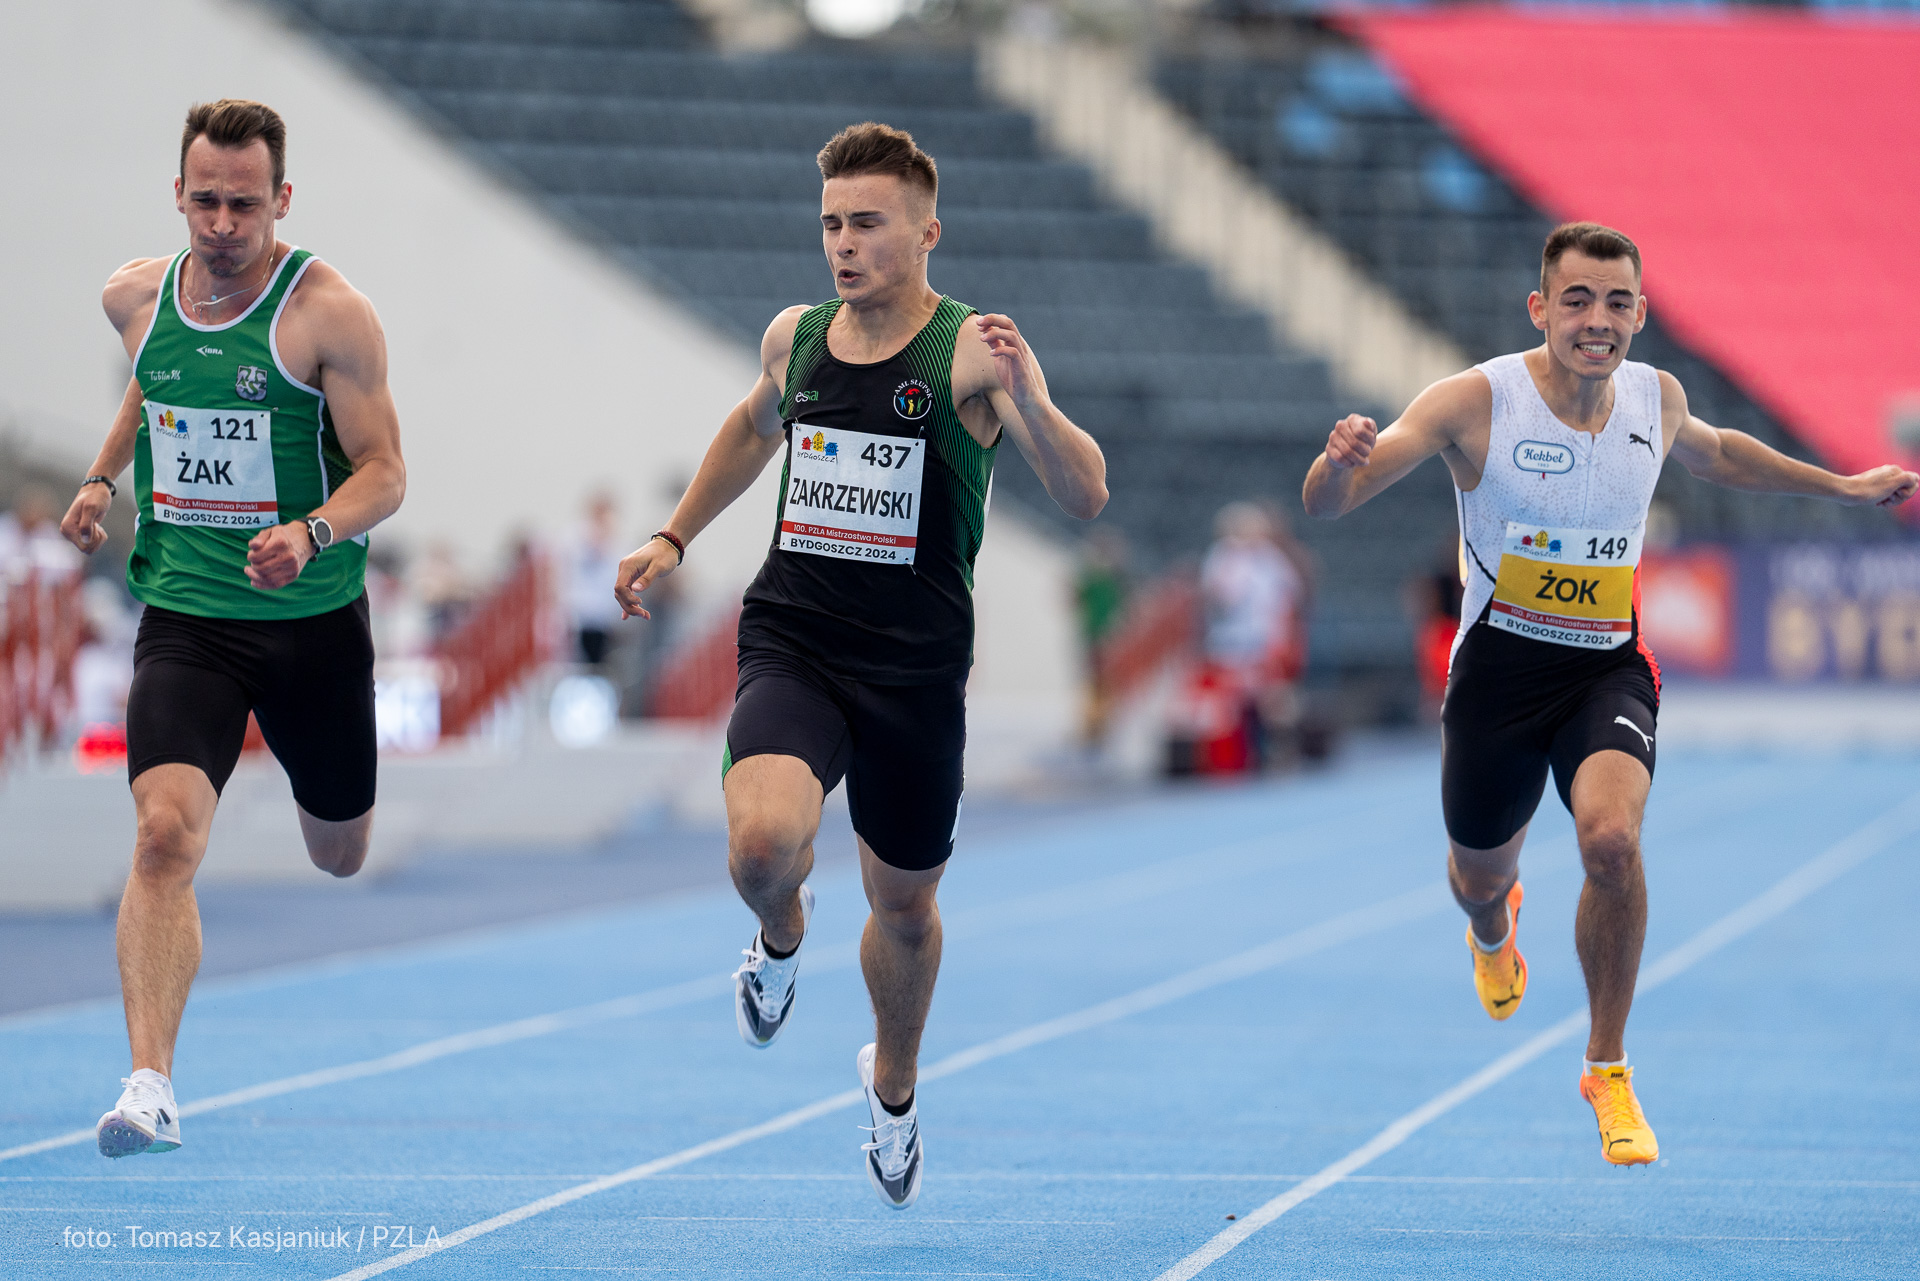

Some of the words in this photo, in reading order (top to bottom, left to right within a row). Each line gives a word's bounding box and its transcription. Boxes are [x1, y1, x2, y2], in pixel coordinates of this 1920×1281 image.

[210, 417, 258, 441] 121
[797, 451, 837, 463] BYDGOSZCZ
[861, 442, 912, 469] 437
[177, 451, 234, 486] ŻAK
[192, 500, 235, 510] Mistrzostwa
[236, 503, 258, 511] Polski
[789, 477, 913, 520] ZAKRZEWSKI
[163, 509, 228, 525] BYDGOSZCZ
[231, 515, 260, 525] 2024
[794, 524, 807, 533] 100.
[808, 527, 825, 536] PZLA
[826, 528, 872, 542] Mistrzostwa
[873, 535, 897, 545] Polski
[790, 537, 862, 557] BYDGOSZCZ
[865, 548, 897, 560] 2024
[1586, 537, 1628, 559] 149
[1535, 569, 1600, 605] ŻOK
[1511, 607, 1524, 617] 100.
[1526, 612, 1544, 622] PZLA
[1545, 616, 1591, 629] Mistrzostwa
[1592, 622, 1613, 630] Polski
[1506, 618, 1581, 642] BYDGOSZCZ
[1583, 634, 1613, 645] 2024
